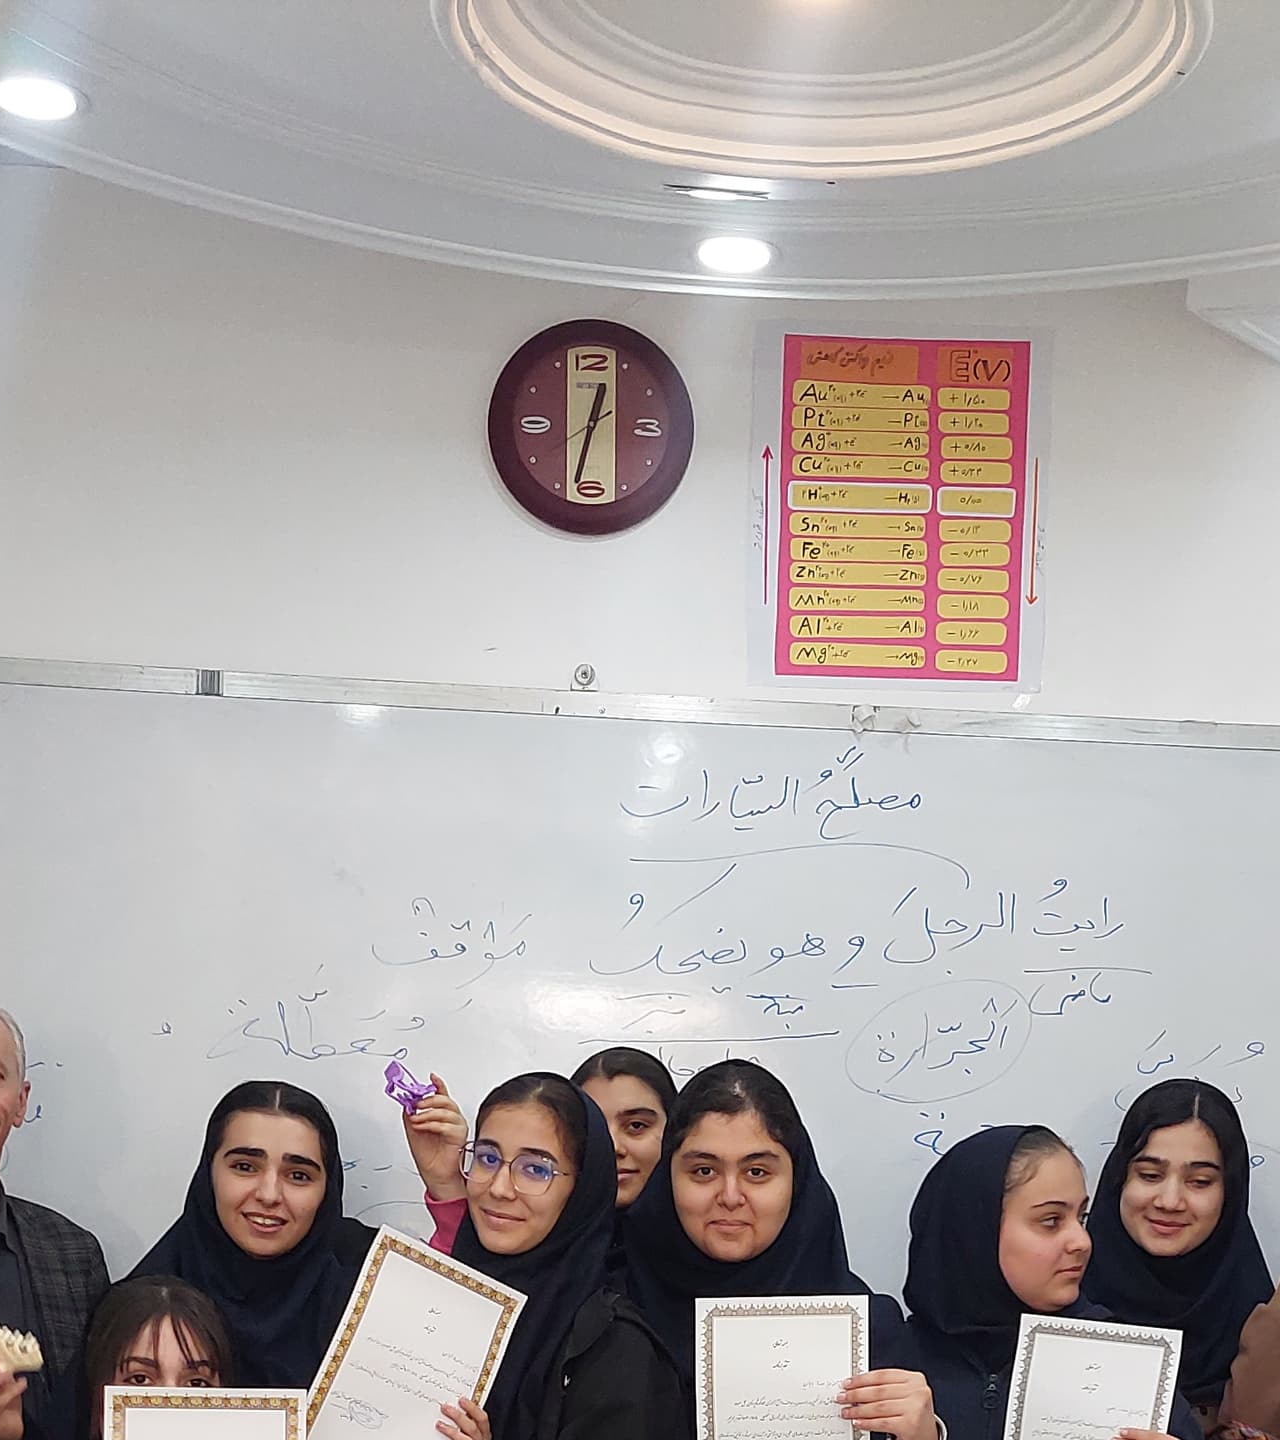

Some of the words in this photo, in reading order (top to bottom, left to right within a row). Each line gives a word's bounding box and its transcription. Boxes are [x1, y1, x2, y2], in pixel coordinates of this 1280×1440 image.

[575, 353, 609, 372] 12
[633, 419, 662, 437] 3
[576, 480, 605, 498] 6
